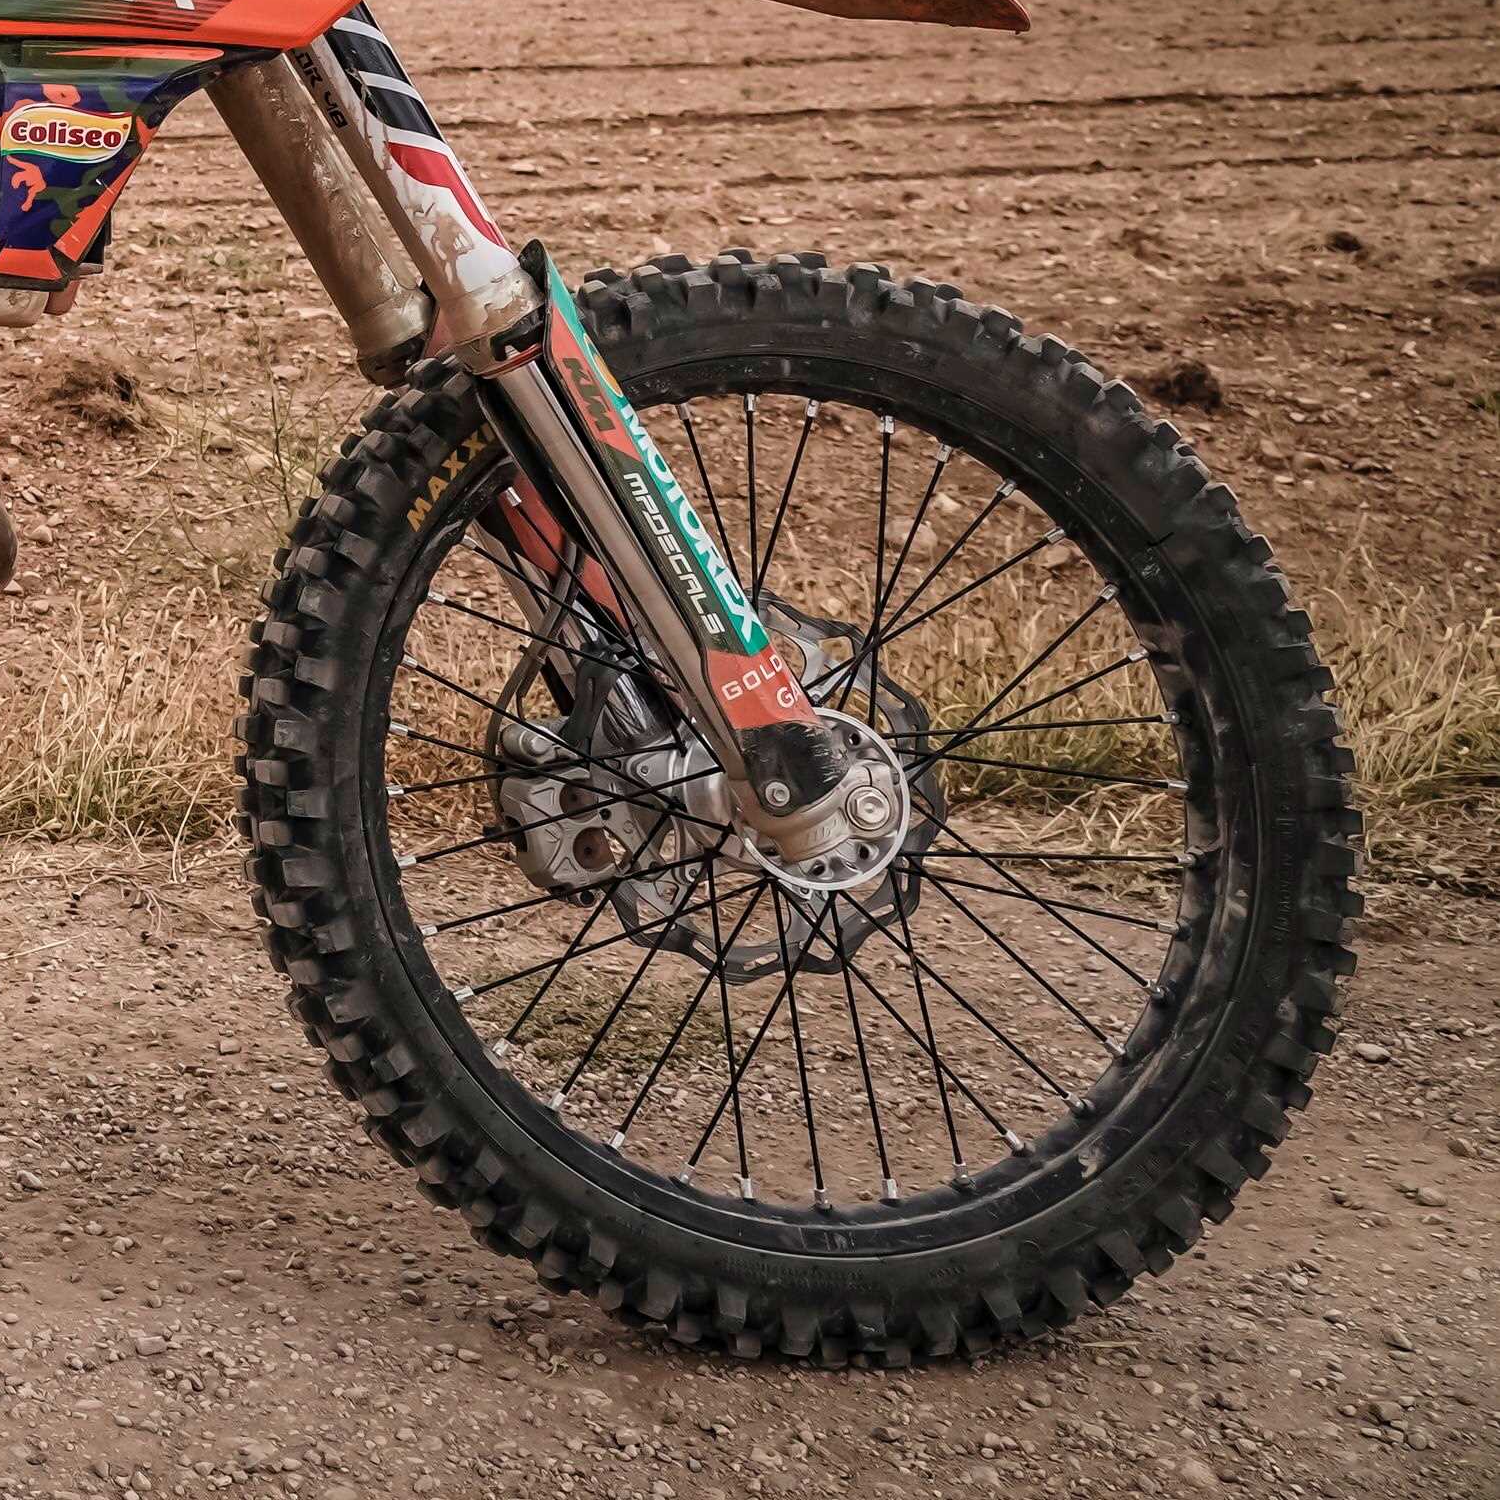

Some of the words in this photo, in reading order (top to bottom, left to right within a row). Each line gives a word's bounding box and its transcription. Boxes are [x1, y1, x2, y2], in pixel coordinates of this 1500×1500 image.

[10, 120, 123, 149] Coliseo
[406, 422, 497, 533] MAXXI
[619, 403, 764, 642] MOTOREX
[721, 653, 783, 701] GOLD
